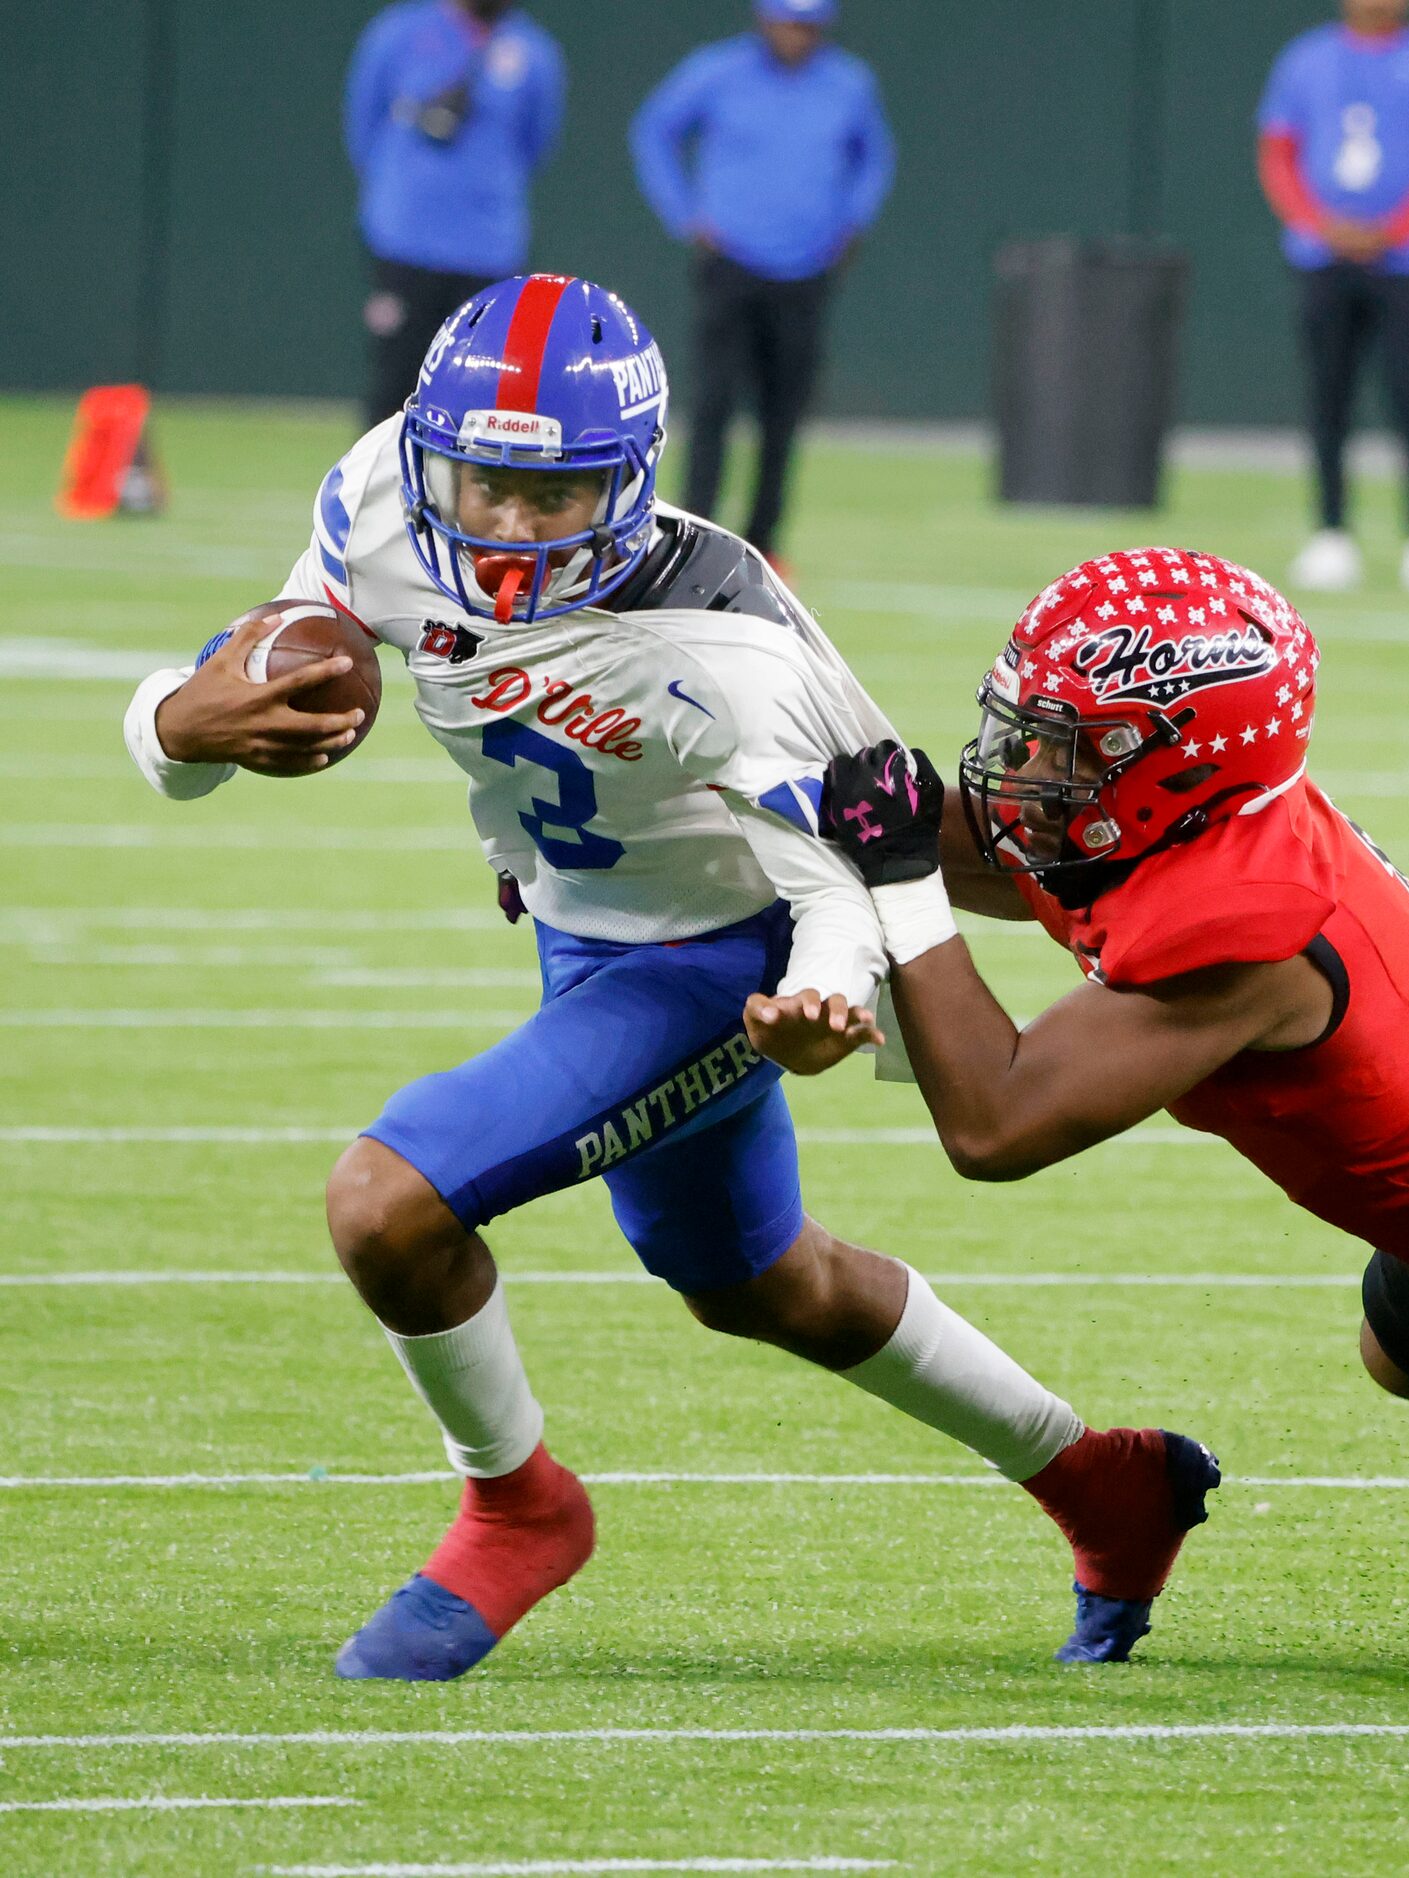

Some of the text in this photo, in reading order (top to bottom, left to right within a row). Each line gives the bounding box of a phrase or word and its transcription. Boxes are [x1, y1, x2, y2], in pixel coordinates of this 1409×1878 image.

[487, 416, 540, 433] Riddell
[1076, 624, 1273, 695] Horns
[471, 667, 643, 761] D'Ville
[1037, 699, 1064, 712] schutt
